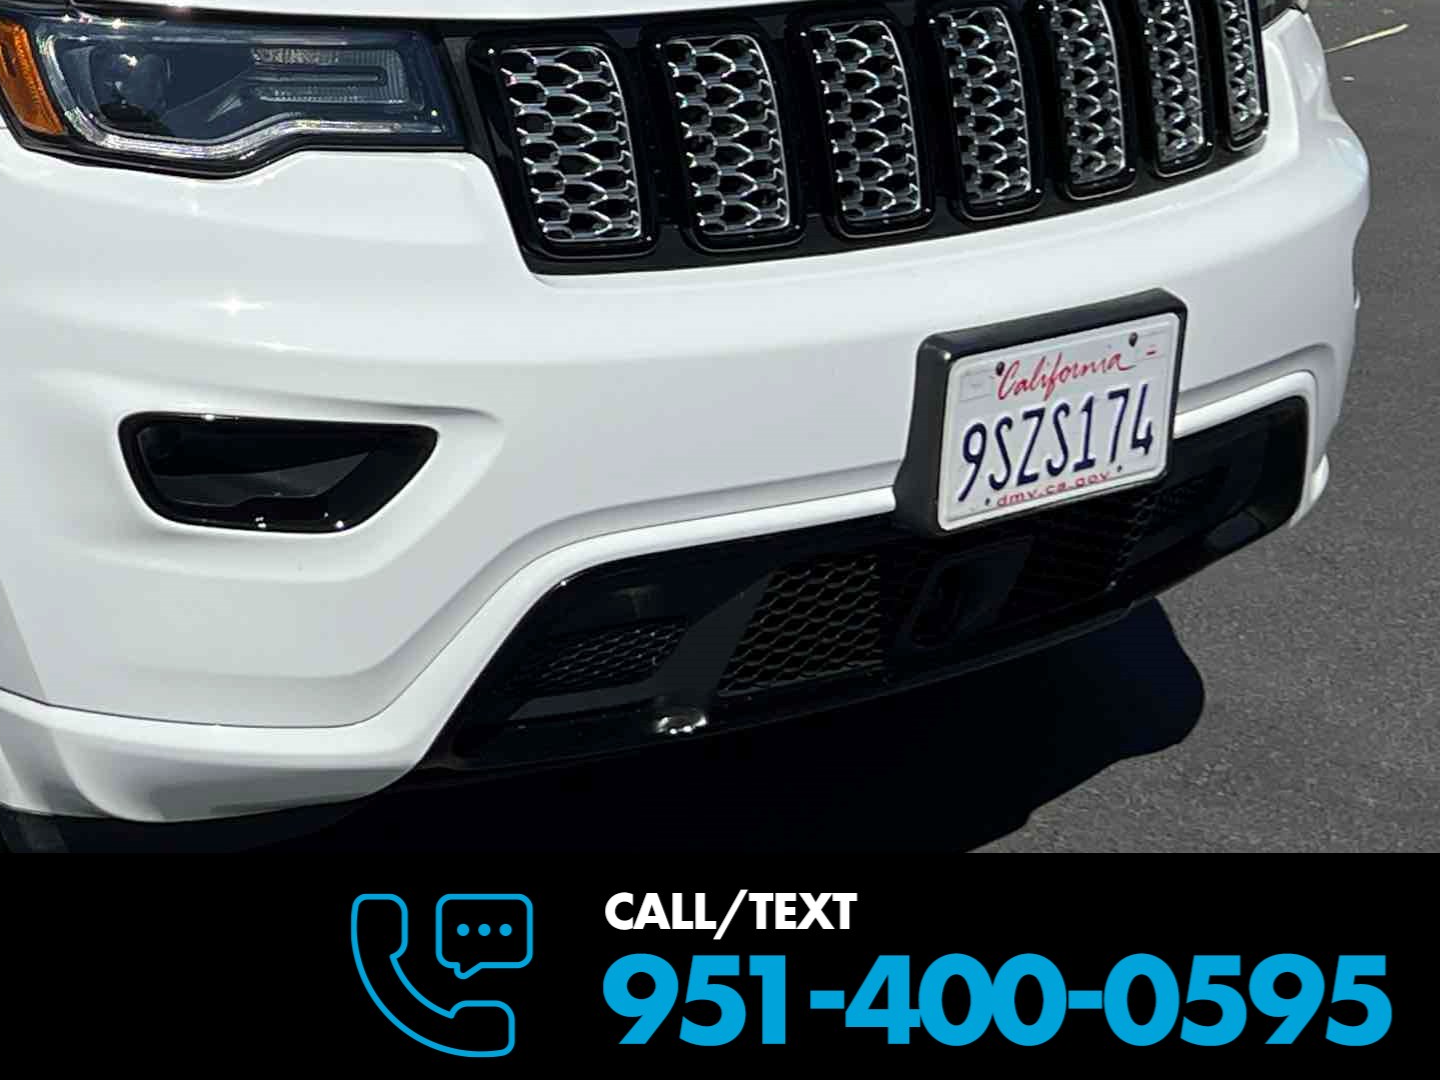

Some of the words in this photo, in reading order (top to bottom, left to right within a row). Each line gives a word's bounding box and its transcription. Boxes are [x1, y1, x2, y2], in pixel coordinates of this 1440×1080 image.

[992, 352, 1136, 401] California
[957, 383, 1154, 503] 9SZS174
[996, 471, 1111, 508] dmv.ca.gov
